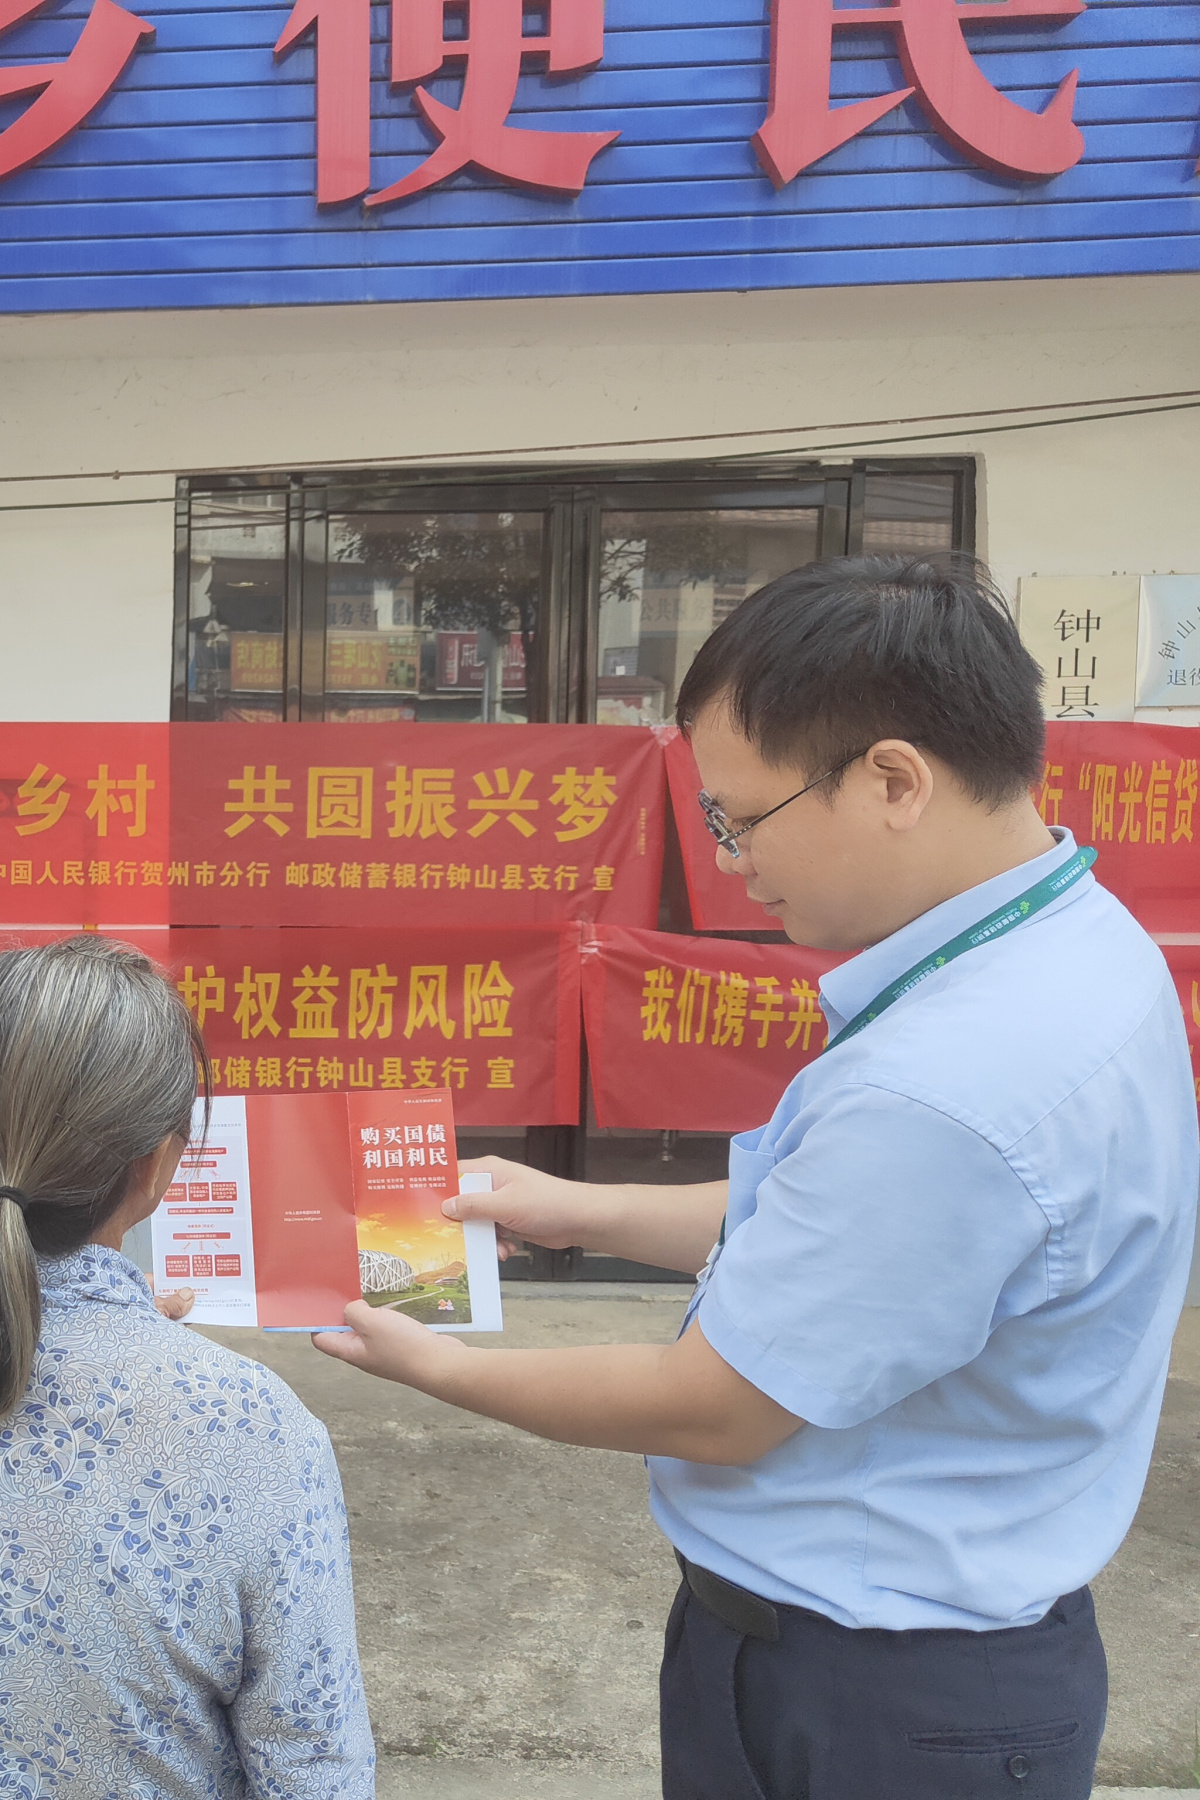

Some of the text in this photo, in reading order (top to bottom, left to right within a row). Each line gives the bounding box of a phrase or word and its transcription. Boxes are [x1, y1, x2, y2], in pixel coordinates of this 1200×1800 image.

[1051, 608, 1101, 718] 钟山县
[1158, 607, 1200, 660] 钟山
[224, 765, 619, 842] 共圆振兴梦
[1030, 760, 1198, 844] 行“阳光信贷
[285, 861, 579, 891] 邮政储蓄银行钟山县支行
[592, 865, 615, 892] 宣
[177, 960, 514, 1040] 护权益防风险
[640, 965, 828, 1051] 我们携手并
[487, 1056, 515, 1089] 宣
[360, 1124, 446, 1146] 购买国债
[362, 1147, 448, 1169] 利国利民
